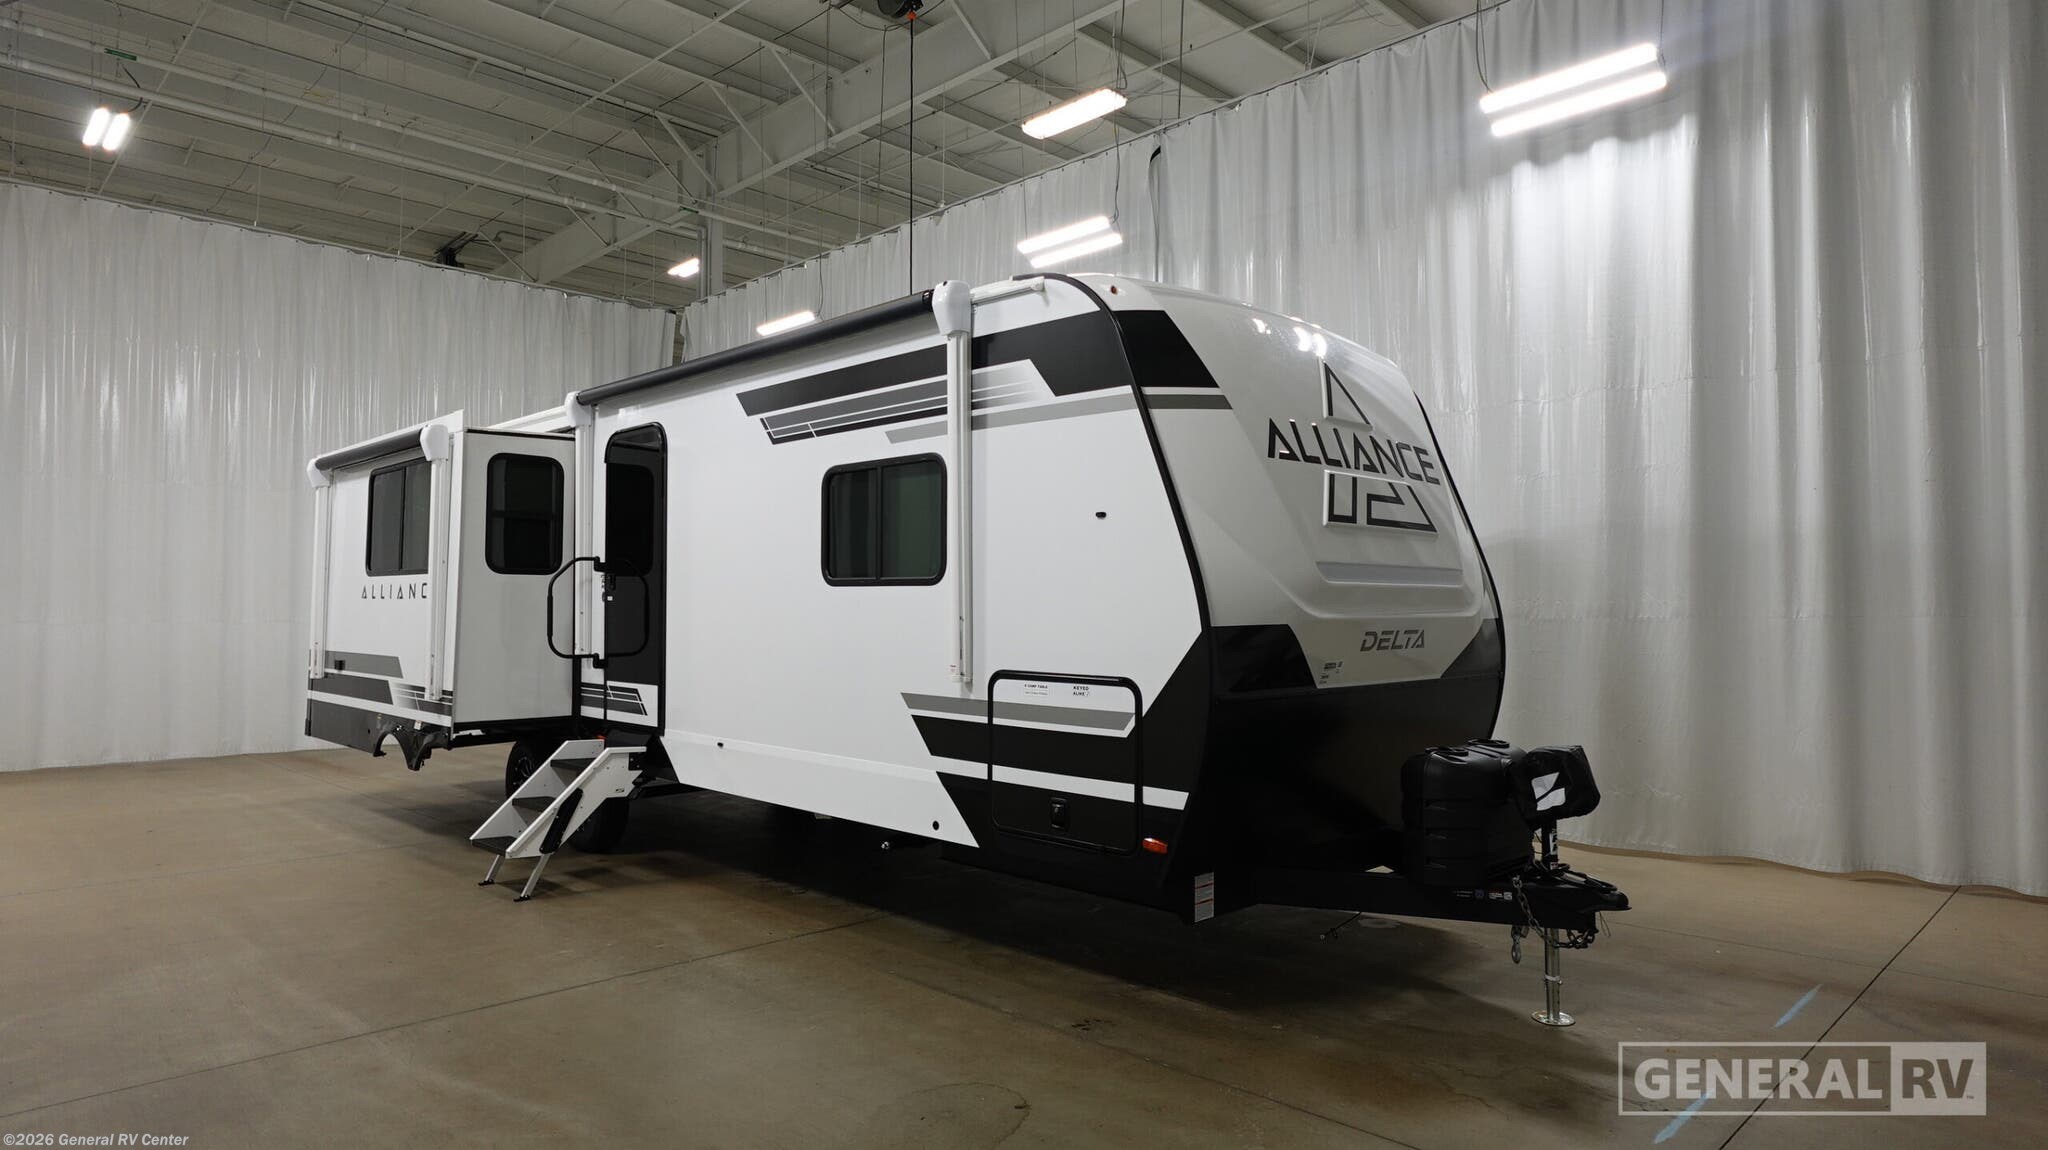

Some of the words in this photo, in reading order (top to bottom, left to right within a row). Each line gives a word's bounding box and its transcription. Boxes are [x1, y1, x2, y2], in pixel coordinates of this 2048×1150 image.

[1268, 417, 1441, 486] ALLIANCE
[361, 582, 428, 600] ALLIANC
[1359, 629, 1425, 652] DELTA
